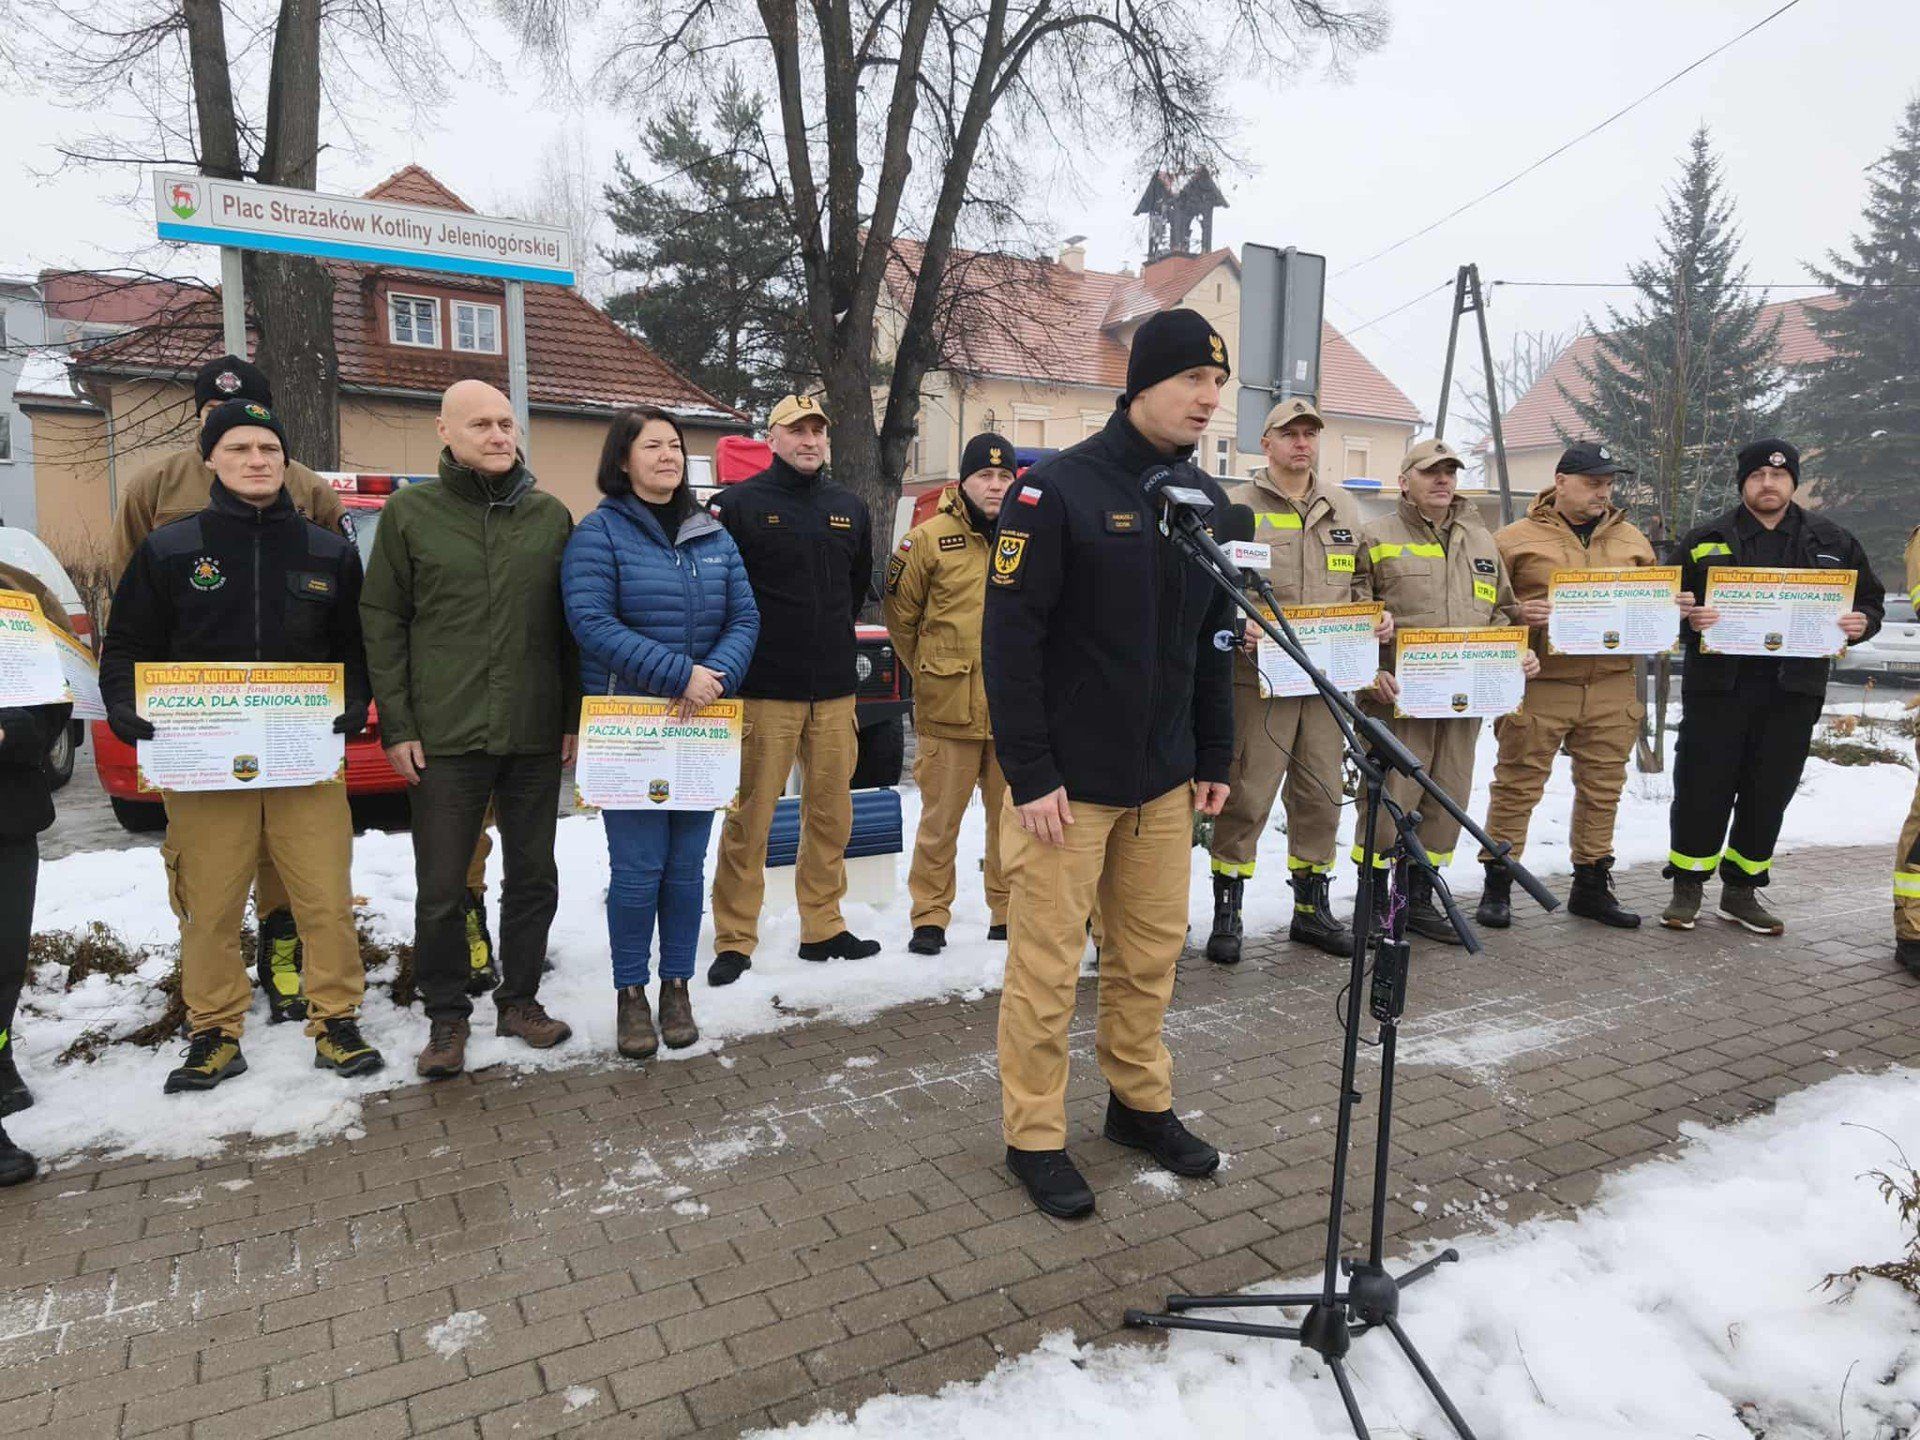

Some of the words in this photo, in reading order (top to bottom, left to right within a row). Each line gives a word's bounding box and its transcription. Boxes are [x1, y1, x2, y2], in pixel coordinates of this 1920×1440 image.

[223, 194, 264, 219] Plac
[270, 200, 365, 232] Strażaków
[371, 214, 432, 246] Kotliny
[438, 223, 560, 262] Jeleniogórskiej
[1555, 589, 1589, 599] PACZKA
[1592, 589, 1610, 598] DLA
[1613, 588, 1651, 598] SENIORA
[1713, 589, 1751, 599] PACZKA
[1755, 590, 1774, 599] DLA
[1778, 591, 1820, 601] SENIORA
[1299, 625, 1315, 635] DLA
[1318, 623, 1353, 633] SENIORA
[1403, 651, 1437, 661] PACZKA
[1441, 650, 1458, 660] DLA
[1462, 650, 1499, 660] SENIORA
[146, 666, 199, 684] STRAŻACY
[202, 668, 247, 684] KOTLINY
[249, 666, 336, 684] JELENIOGÓRSKIEJ
[148, 696, 206, 708] PACZKA
[211, 695, 239, 707] DLA
[244, 694, 302, 707] SENIORA
[589, 700, 629, 715] STRAŻACY
[588, 725, 631, 736] PACZKA
[636, 726, 657, 737] DLA
[661, 727, 707, 738] SENIORA
